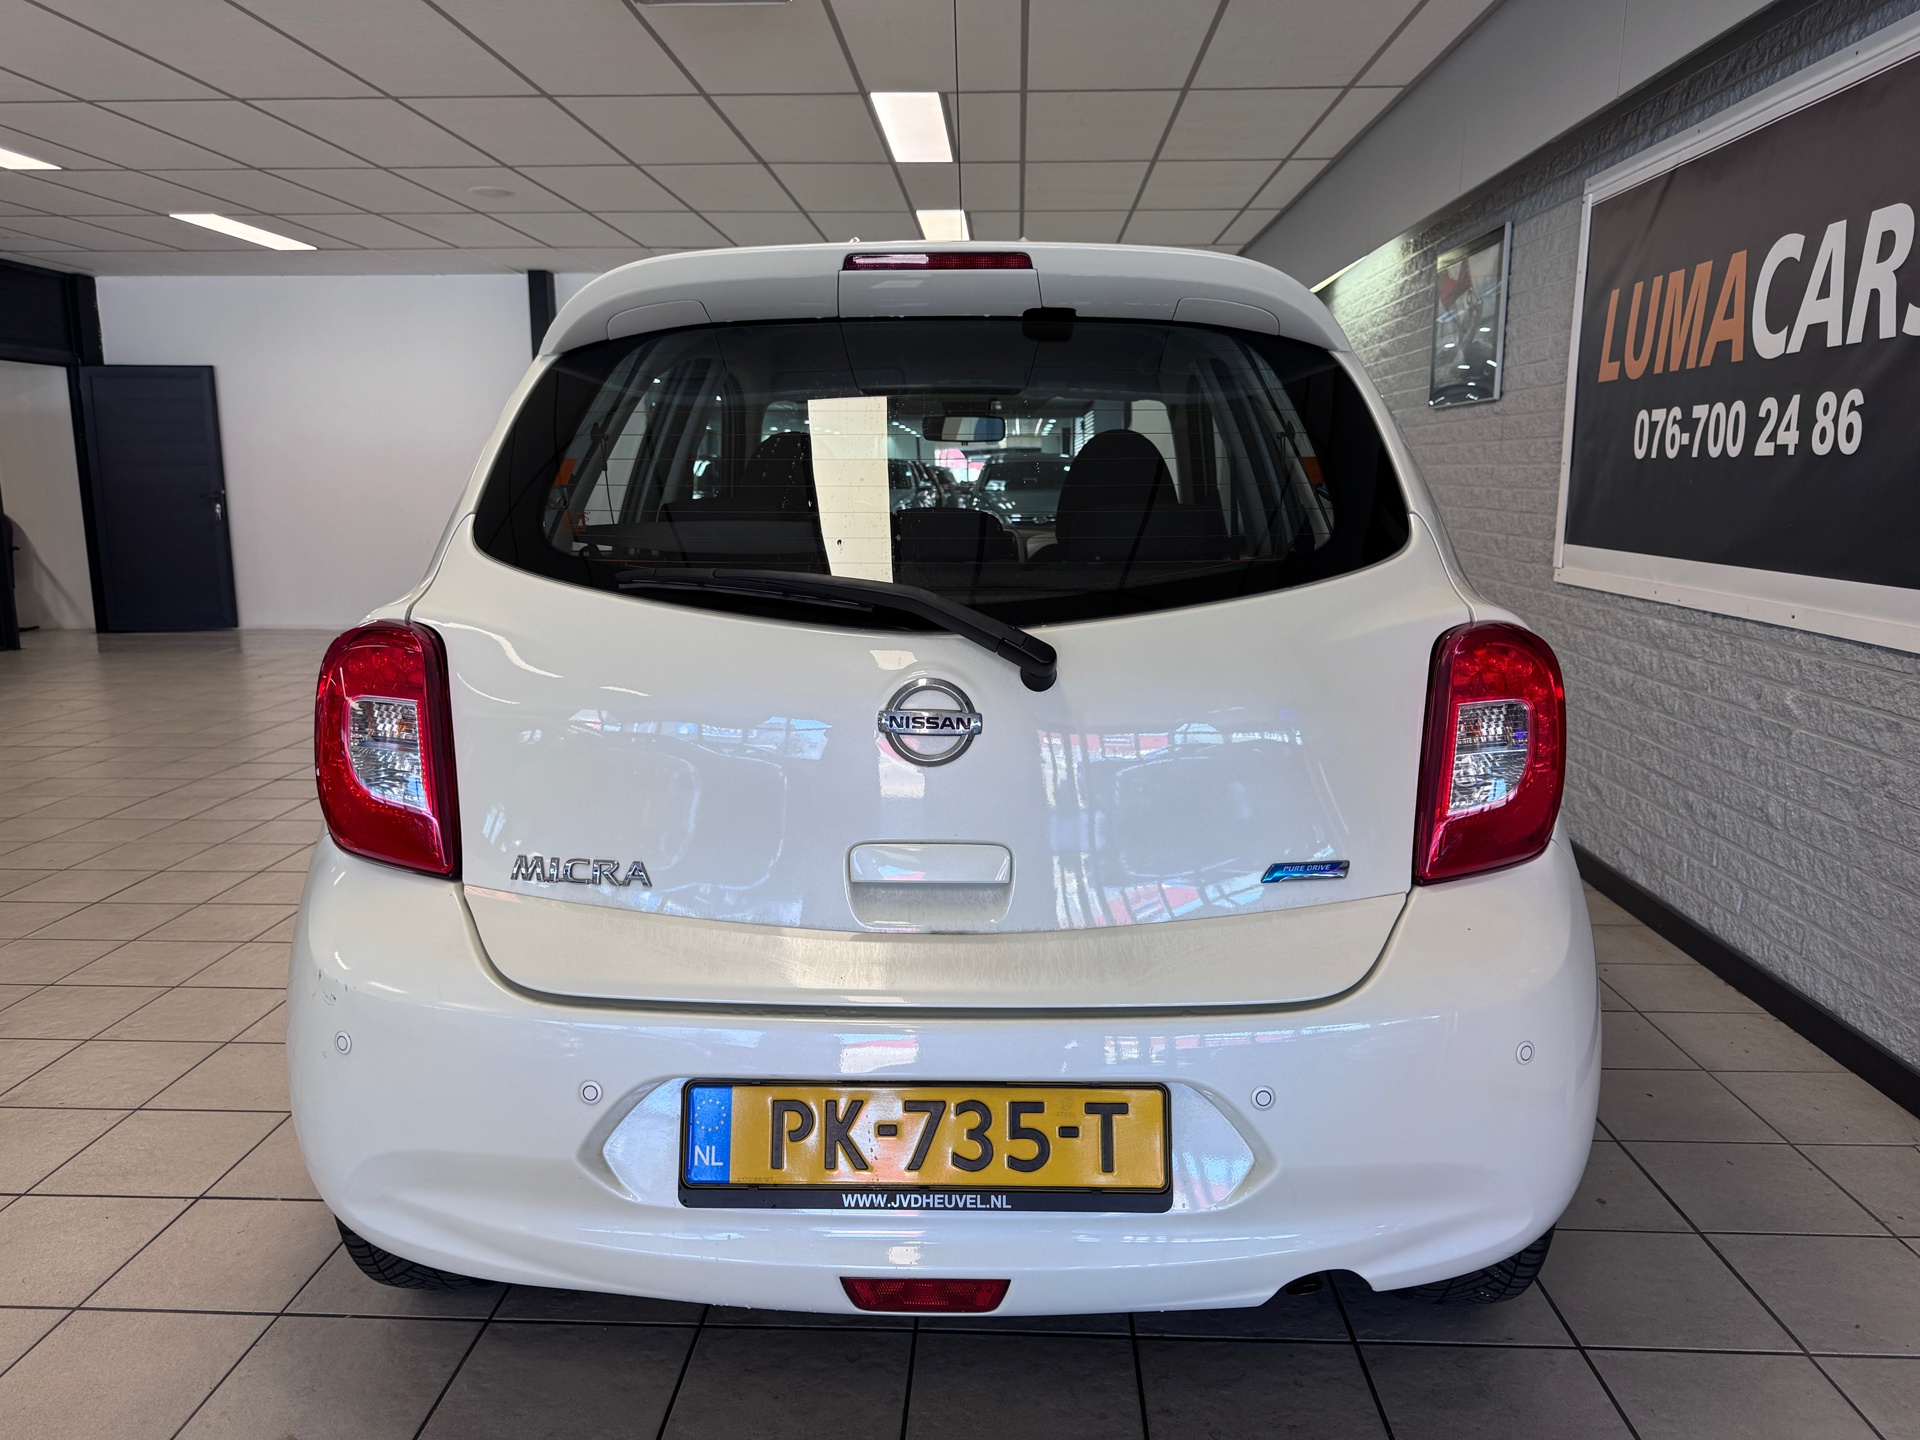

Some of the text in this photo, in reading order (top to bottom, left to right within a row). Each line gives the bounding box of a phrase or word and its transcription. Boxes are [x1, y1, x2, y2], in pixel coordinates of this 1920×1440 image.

[1633, 388, 1865, 460] 076-700 24 86
[889, 715, 972, 730] NISSAN
[510, 854, 653, 888] MICRA
[770, 1099, 1130, 1173] PK-735-T
[693, 1145, 724, 1167] NL
[842, 1193, 1012, 1209] WWW.JVDHEUVEL.NL
